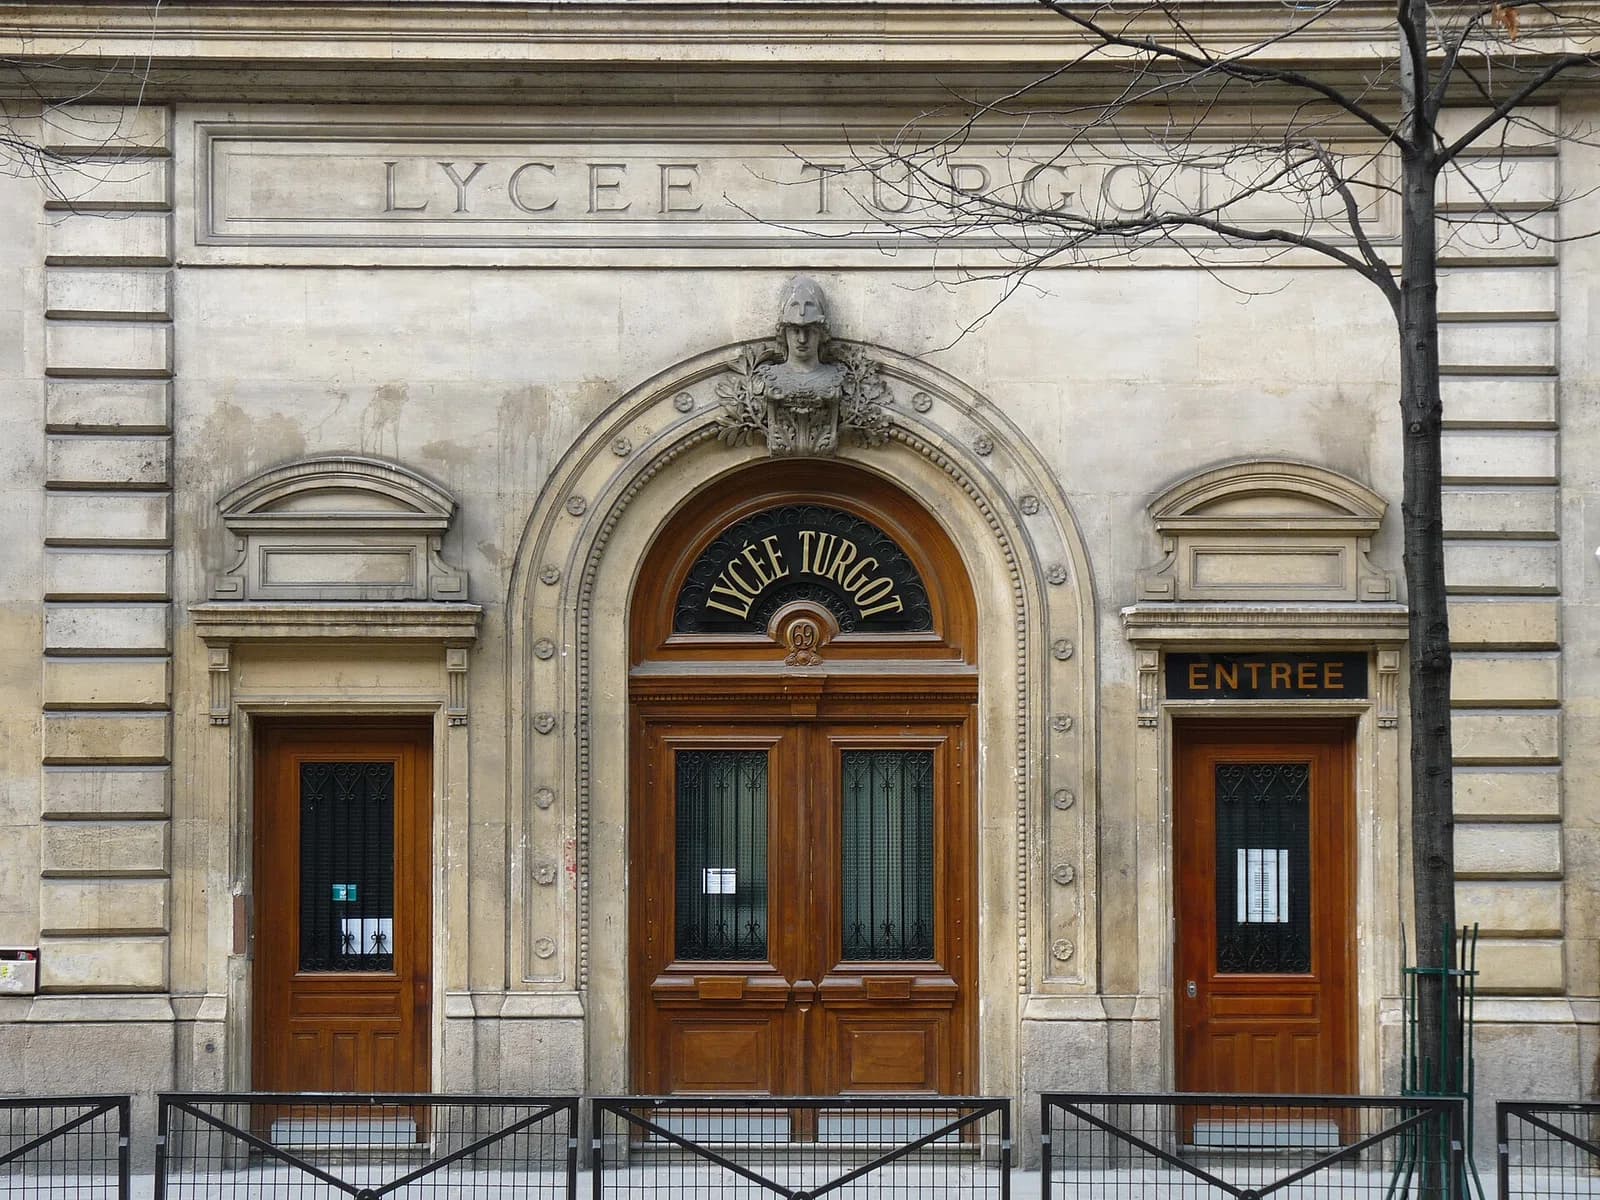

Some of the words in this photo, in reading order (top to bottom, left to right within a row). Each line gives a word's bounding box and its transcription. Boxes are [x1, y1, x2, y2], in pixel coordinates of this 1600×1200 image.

[383, 161, 703, 213] LYCEE
[800, 162, 1223, 215] TURGOT
[705, 534, 790, 621] LYCÉE
[798, 530, 904, 620] TURGOT
[792, 623, 815, 647] 69
[1188, 662, 1345, 690] ENTREE
